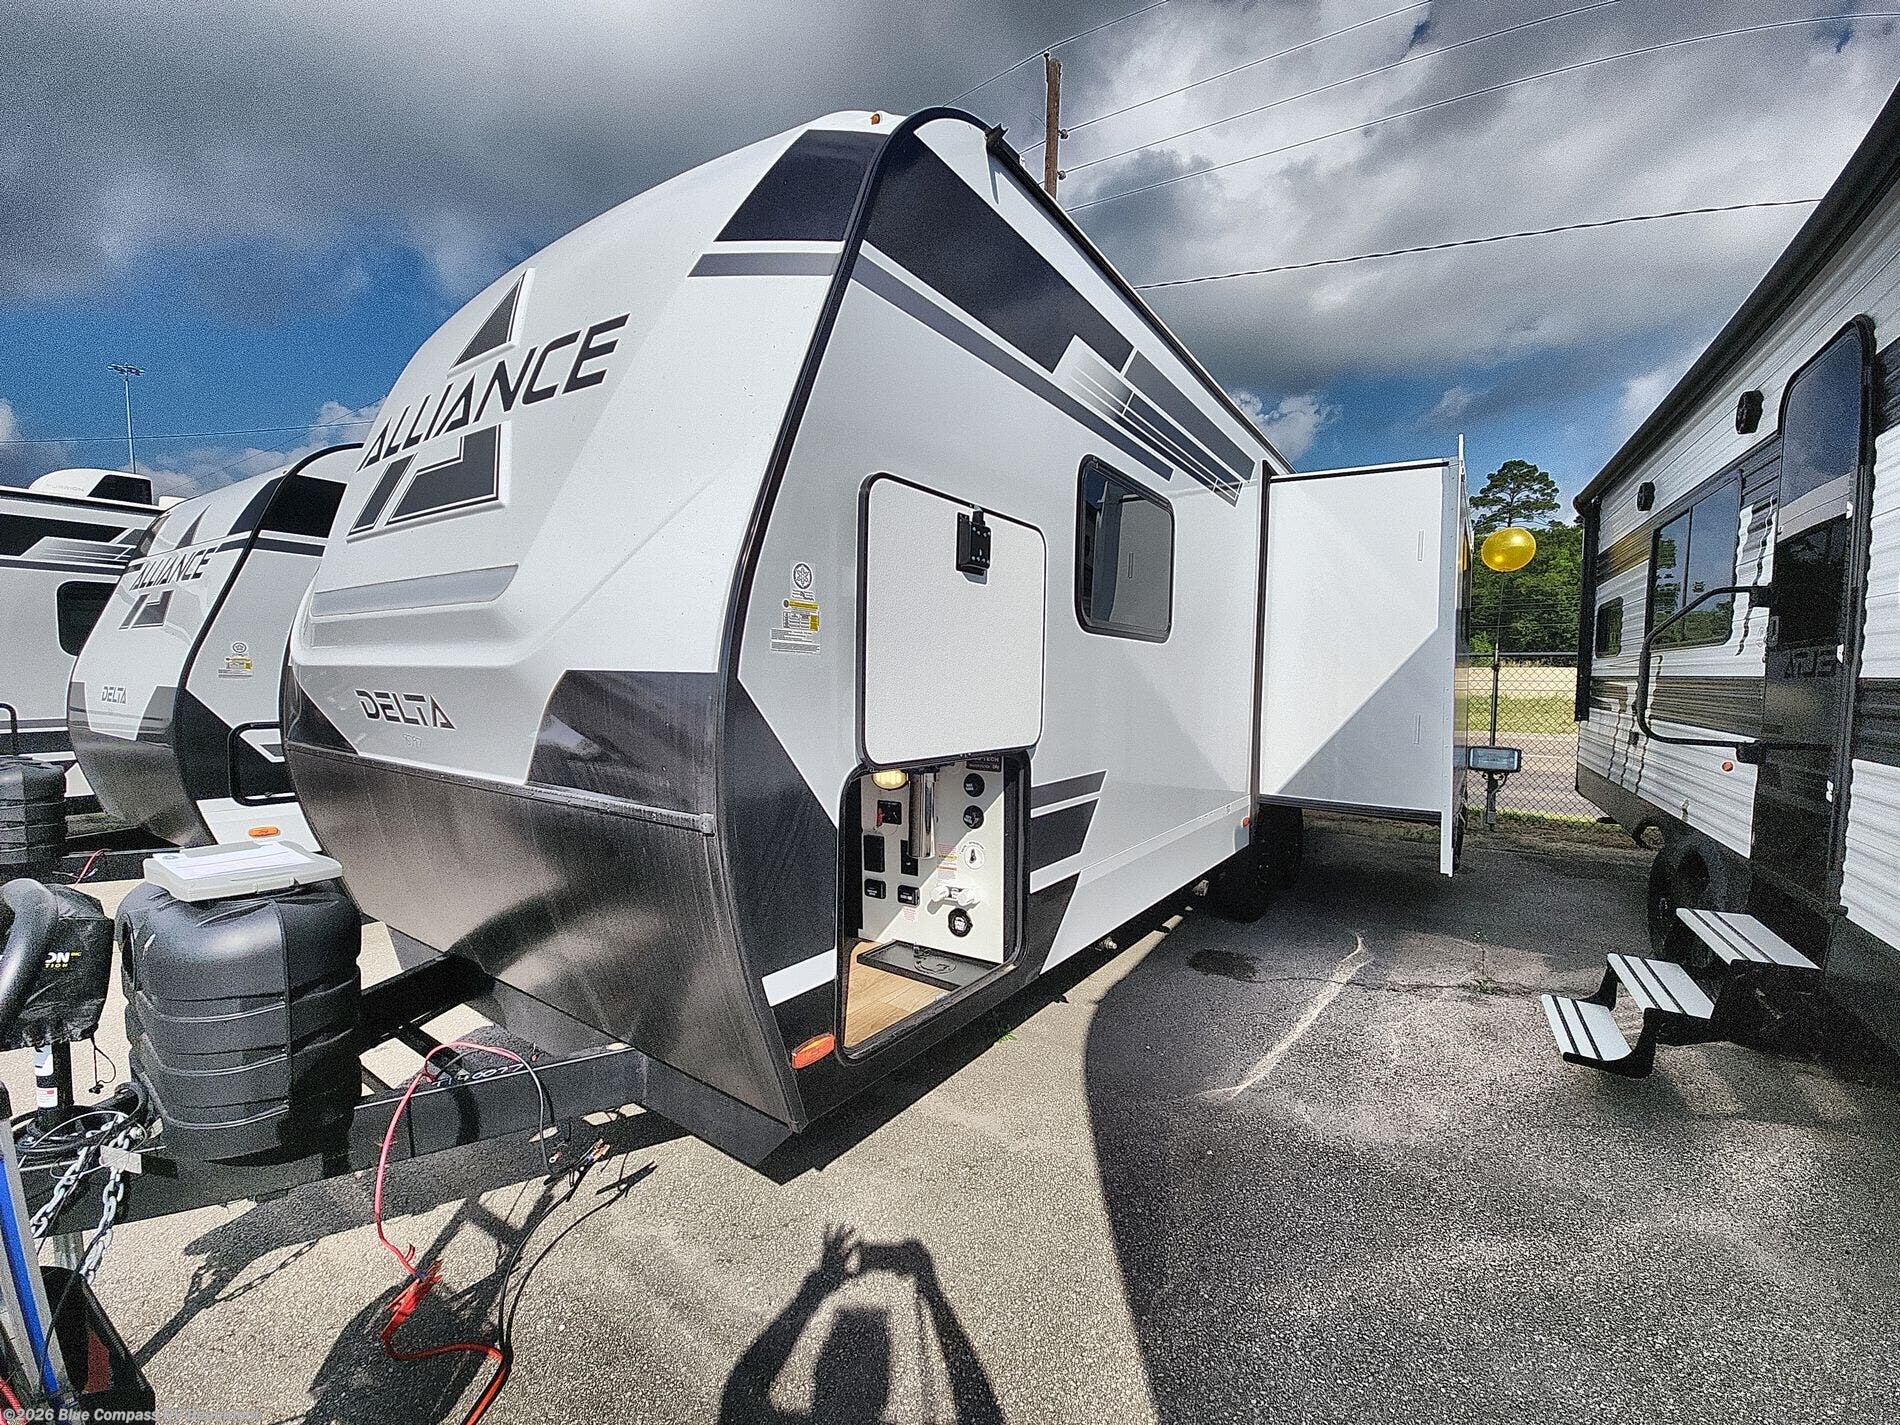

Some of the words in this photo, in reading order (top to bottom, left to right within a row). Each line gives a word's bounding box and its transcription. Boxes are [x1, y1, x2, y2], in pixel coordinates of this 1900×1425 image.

[355, 312, 631, 473] ALLIANCE
[129, 547, 219, 591] ALLIANCE
[101, 685, 127, 704] DELTA
[354, 689, 457, 730] DELTA
